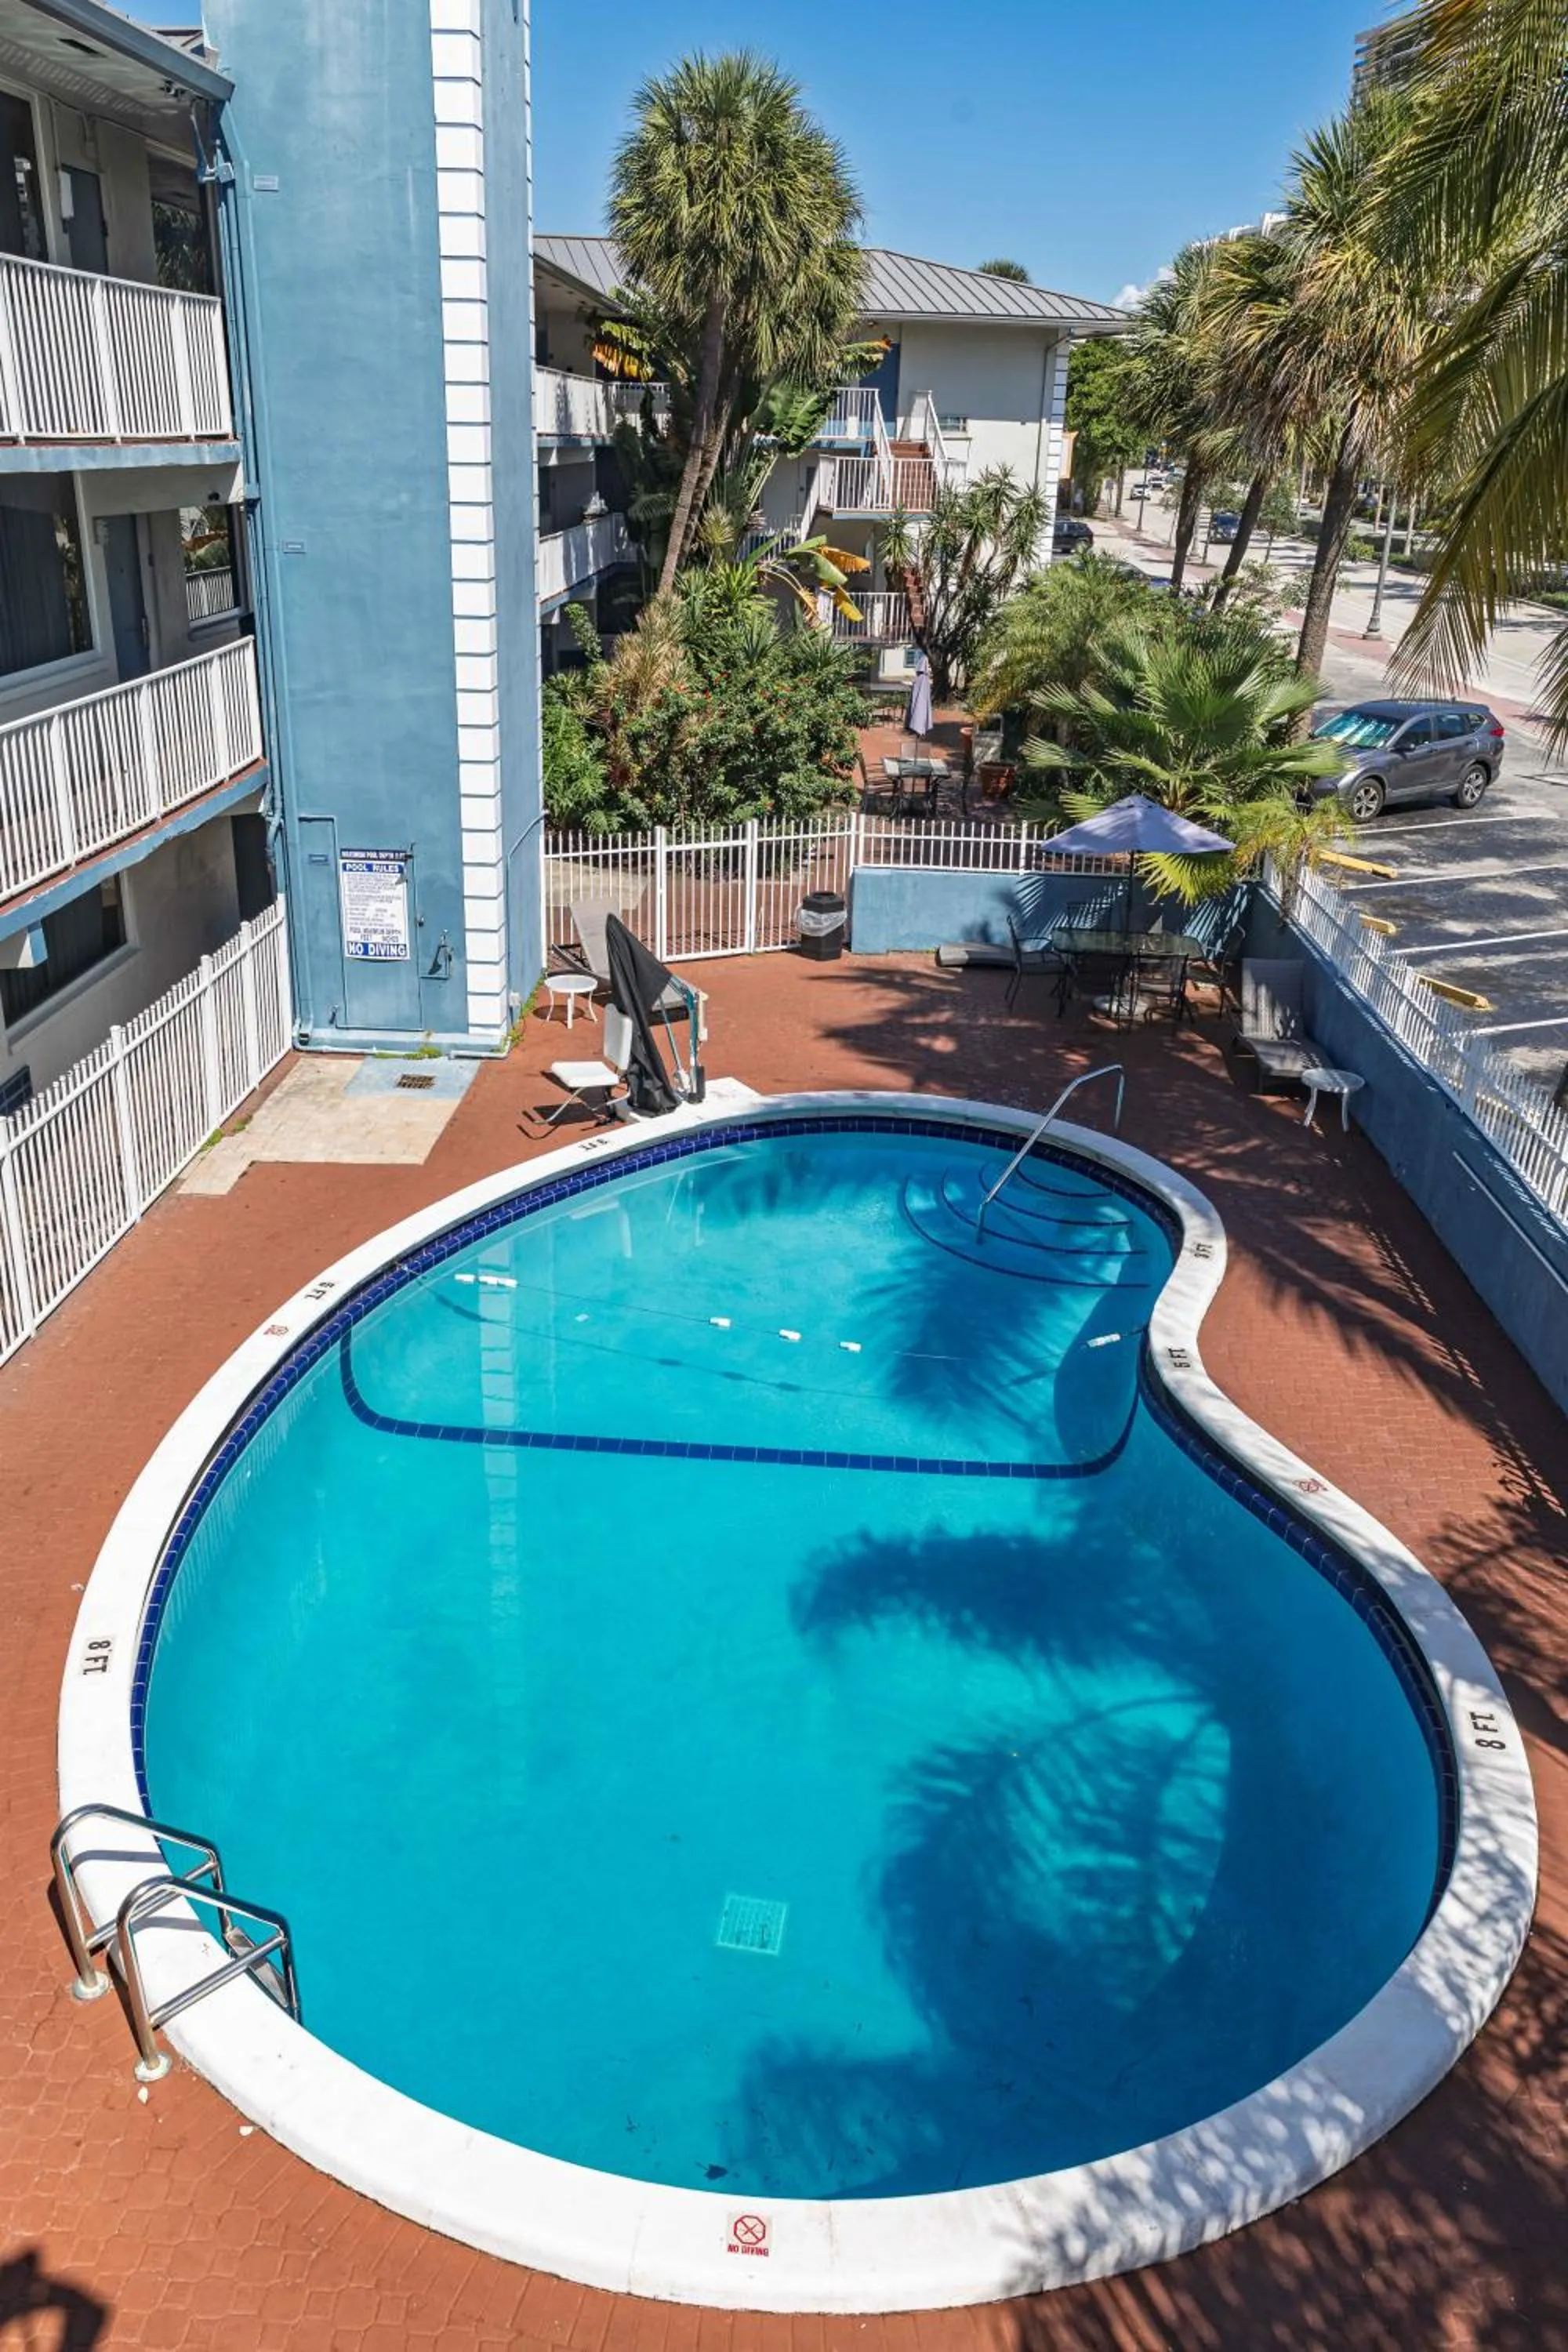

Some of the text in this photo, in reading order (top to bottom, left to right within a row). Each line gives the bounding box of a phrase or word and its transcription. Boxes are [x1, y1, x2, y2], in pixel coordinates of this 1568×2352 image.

[346, 862, 398, 873] POOL RULES
[349, 942, 405, 956] NO DIVING
[303, 1289, 326, 1300] FT
[1168, 1348, 1188, 1358] FT
[83, 1640, 111, 1675] 8 FT
[1469, 1711, 1506, 1750] 8 FT
[728, 2244, 769, 2257] NO DIVING
